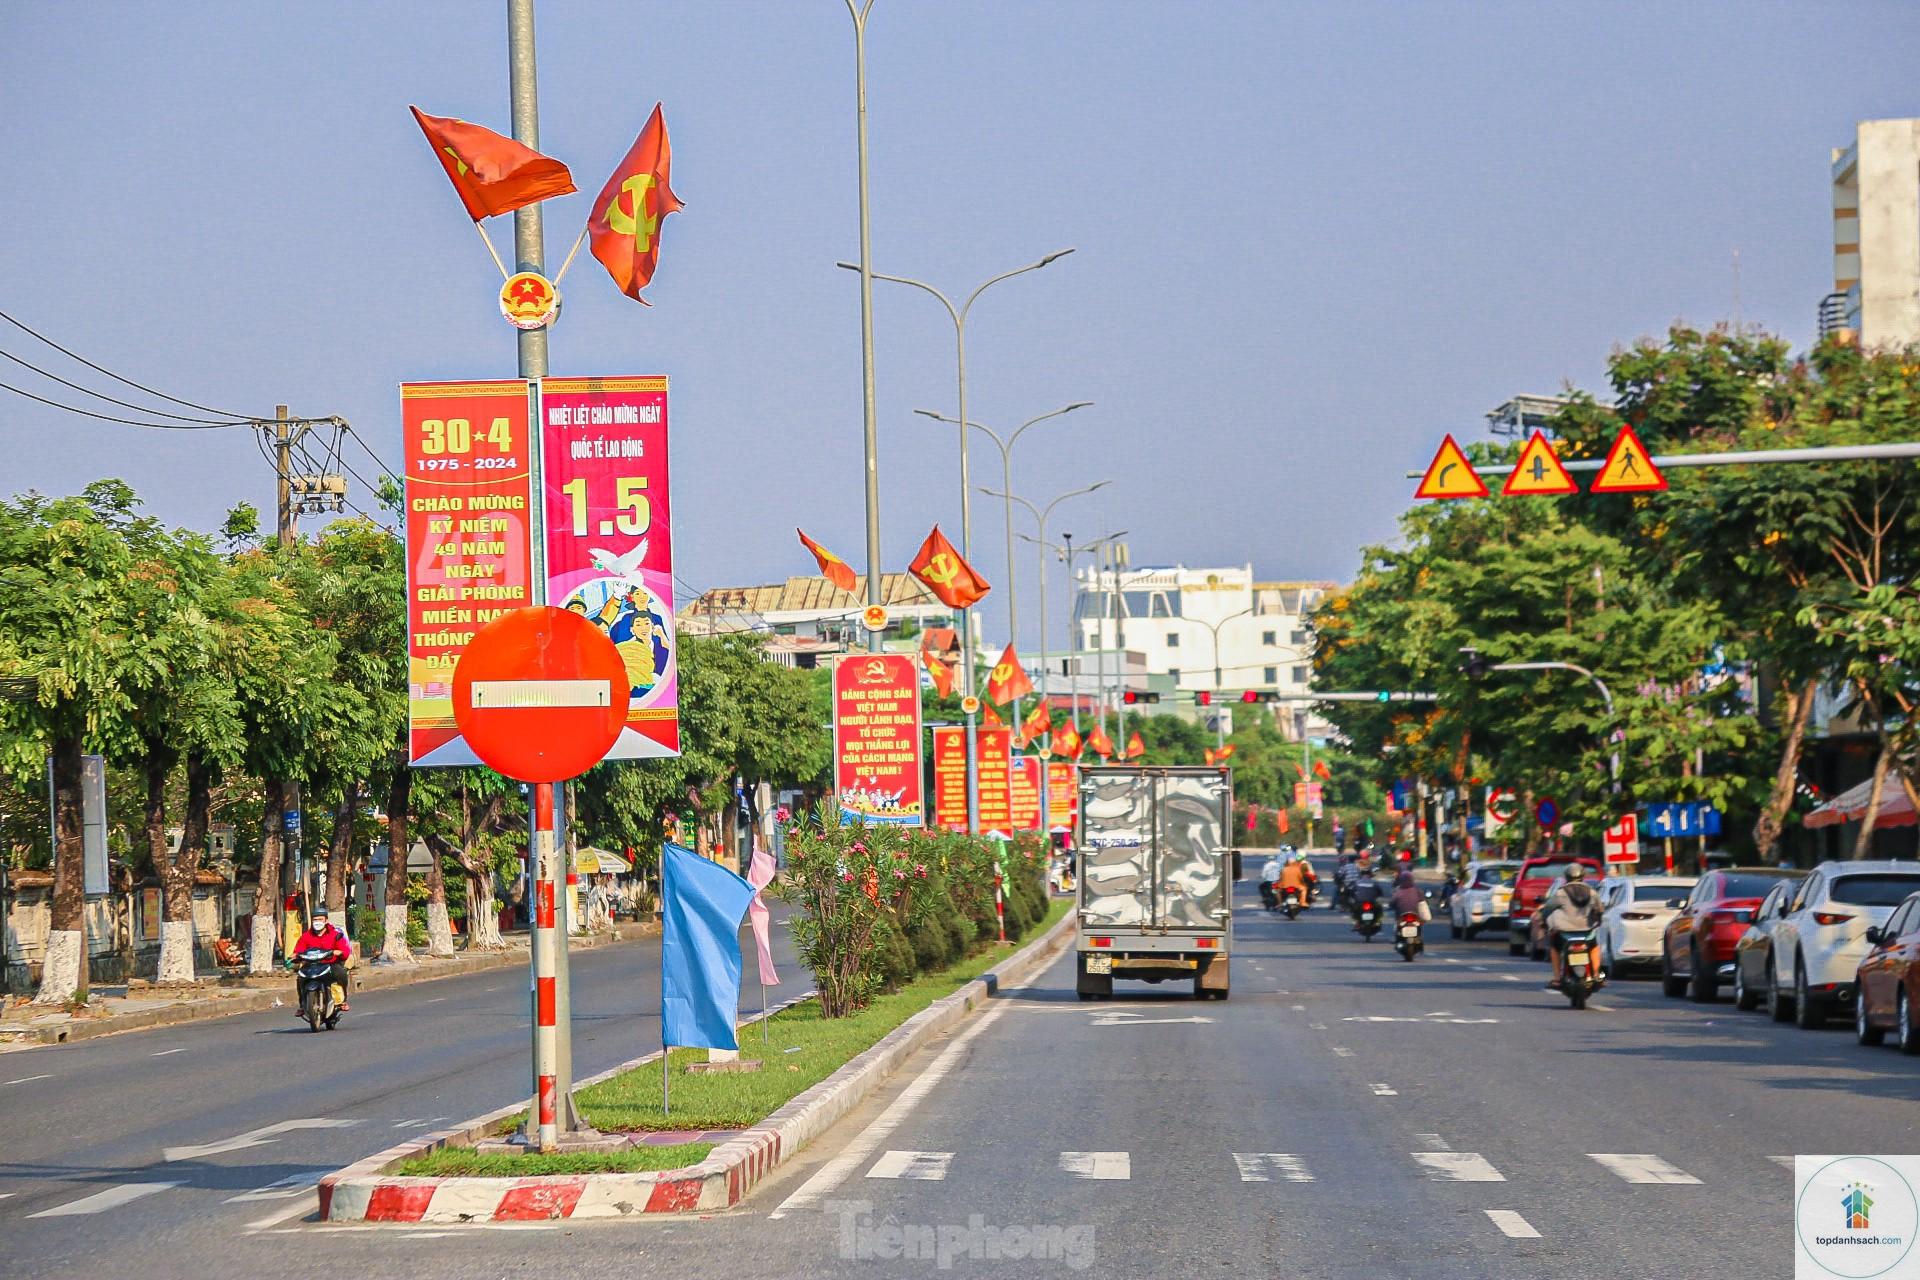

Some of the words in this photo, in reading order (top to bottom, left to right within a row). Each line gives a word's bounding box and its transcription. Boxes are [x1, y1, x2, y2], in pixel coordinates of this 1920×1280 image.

[548, 403, 572, 430] NHIỆT
[573, 403, 590, 429] LIỆT
[591, 402, 613, 425] CHÀO
[614, 402, 638, 424] MỪNG
[639, 402, 661, 424] NGÀY
[421, 418, 472, 455] 30
[487, 417, 513, 453] 4
[571, 434, 592, 461] QUỐC
[593, 434, 605, 458] TẾ
[605, 440, 620, 458] LAO
[621, 436, 644, 462] ĐỘNG
[417, 459, 460, 471] 1975
[474, 457, 518, 470] 2024
[412, 494, 463, 512] CHÀO
[467, 493, 525, 511] MỪNG
[562, 476, 652, 537] 1.5
[459, 516, 508, 535] NIỆM
[433, 542, 457, 556] 49
[461, 539, 505, 556] NĂM
[445, 561, 495, 579] NGÀY
[417, 584, 456, 602] GIẢI
[476, 608, 519, 623] NA
[856, 702, 875, 714] VIỆT
[876, 702, 898, 712] NAM
[855, 765, 875, 777] VIỆT
